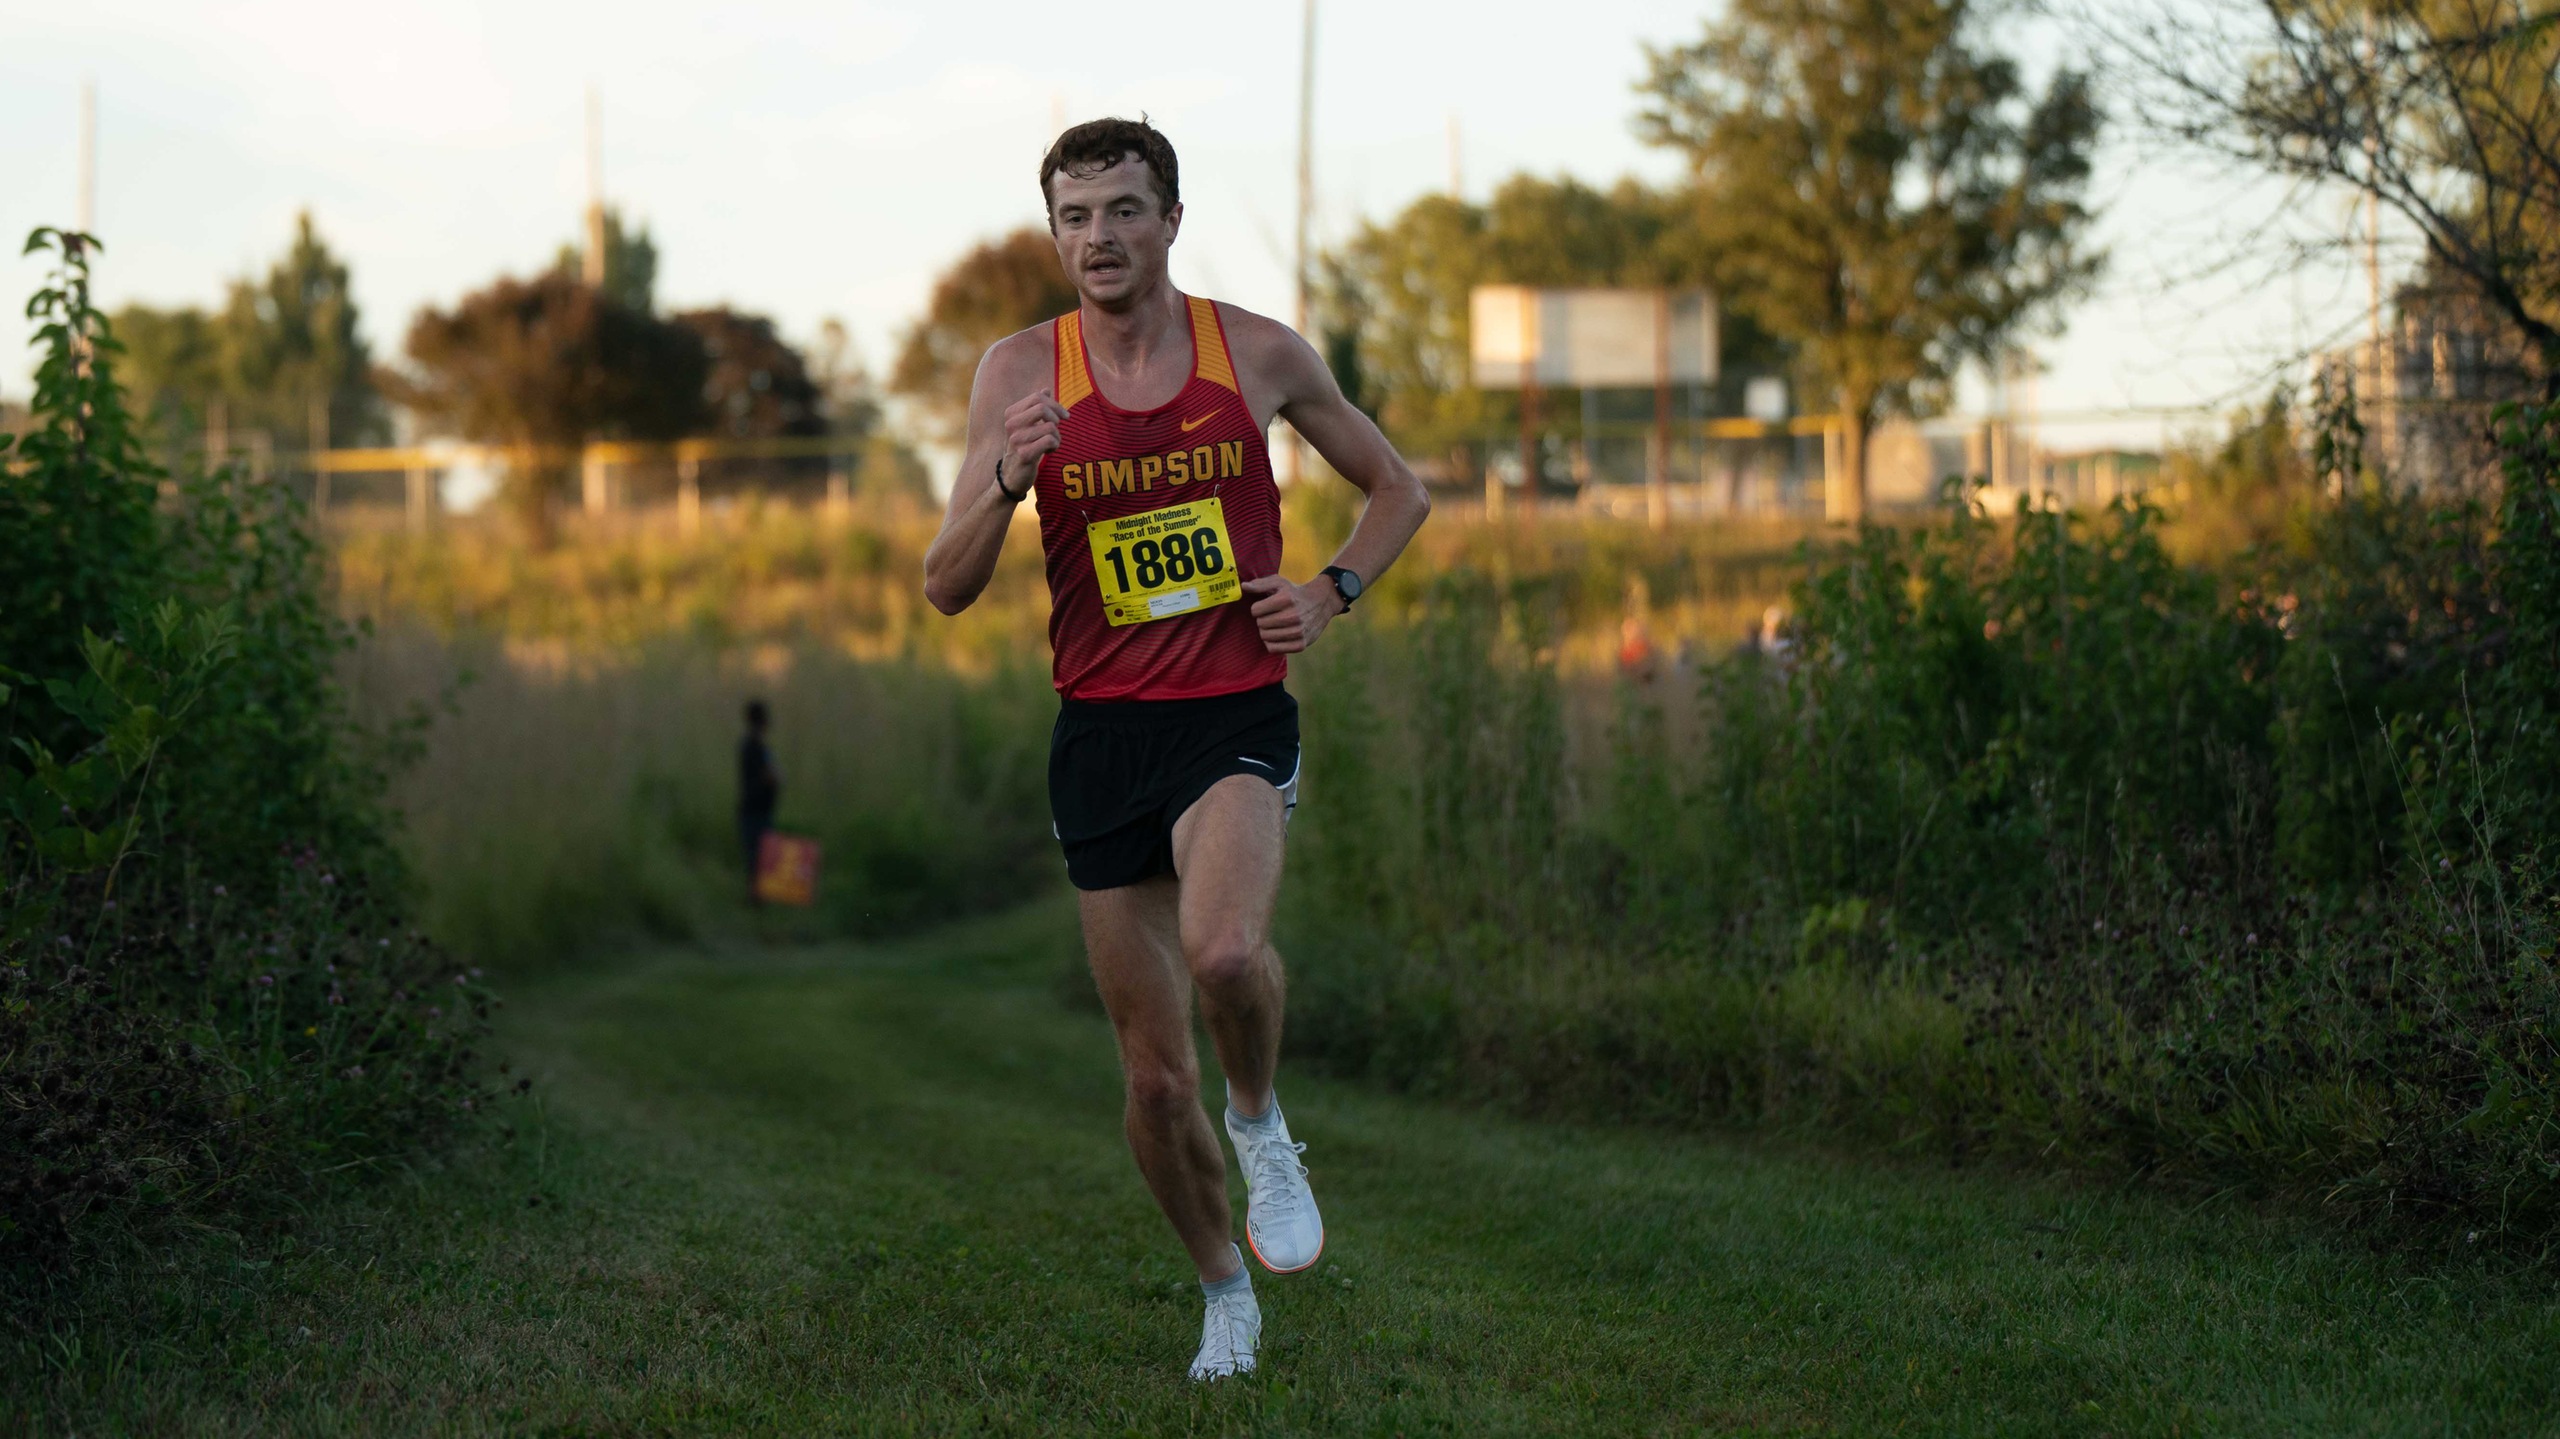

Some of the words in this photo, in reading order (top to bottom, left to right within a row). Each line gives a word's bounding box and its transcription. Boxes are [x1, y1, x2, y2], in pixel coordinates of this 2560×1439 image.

[1062, 441, 1243, 499] SIMPSON
[1116, 515, 1152, 531] Midnight
[1153, 507, 1191, 522] Madness
[1136, 527, 1145, 537] of
[1147, 525, 1161, 536] the
[1104, 527, 1224, 594] 1886
